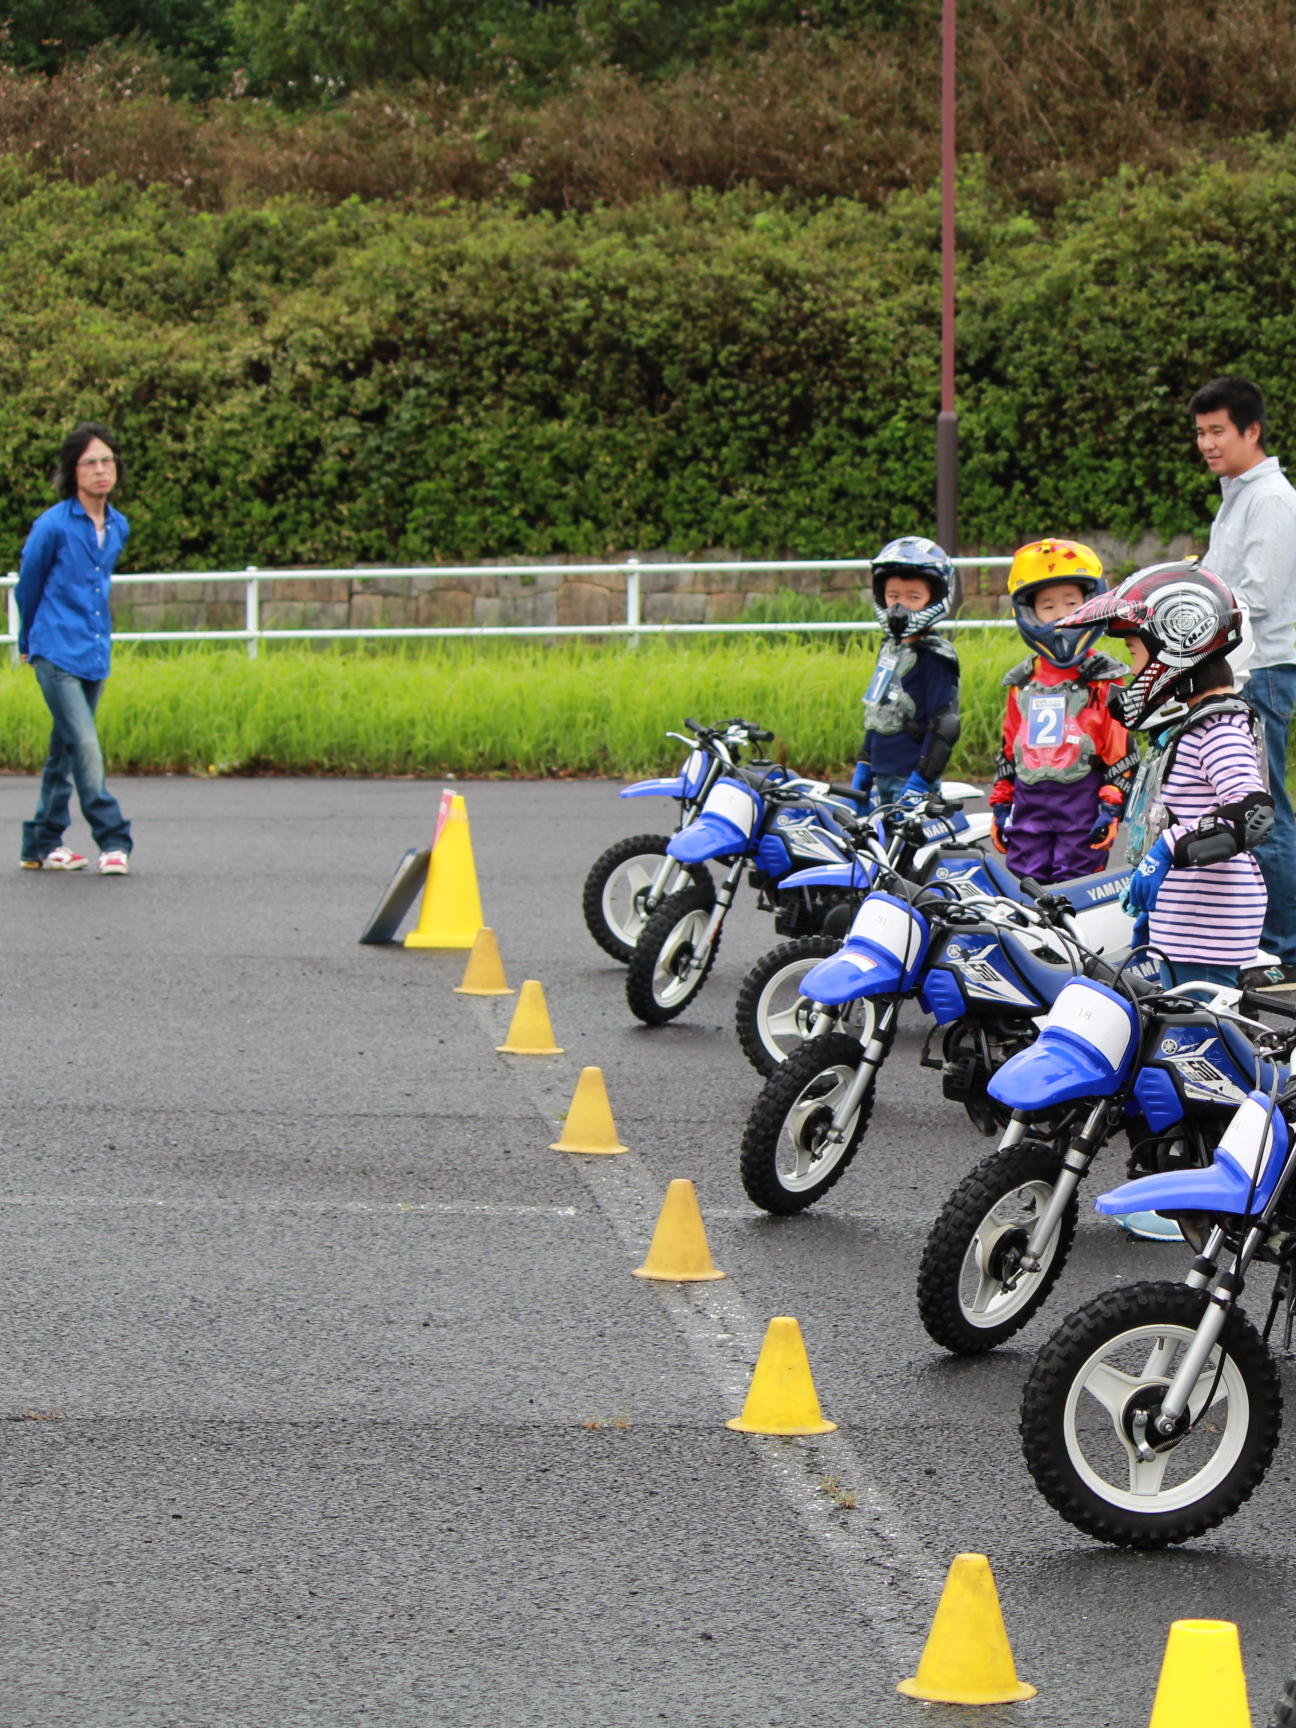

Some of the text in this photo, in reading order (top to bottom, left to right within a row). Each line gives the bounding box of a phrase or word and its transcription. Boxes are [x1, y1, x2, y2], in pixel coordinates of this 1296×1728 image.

[1187, 618, 1213, 645] HJC
[872, 669, 887, 699] 1
[1036, 709, 1057, 744] 2
[1104, 752, 1139, 780] YAMAH
[1087, 876, 1131, 901] YAMAH
